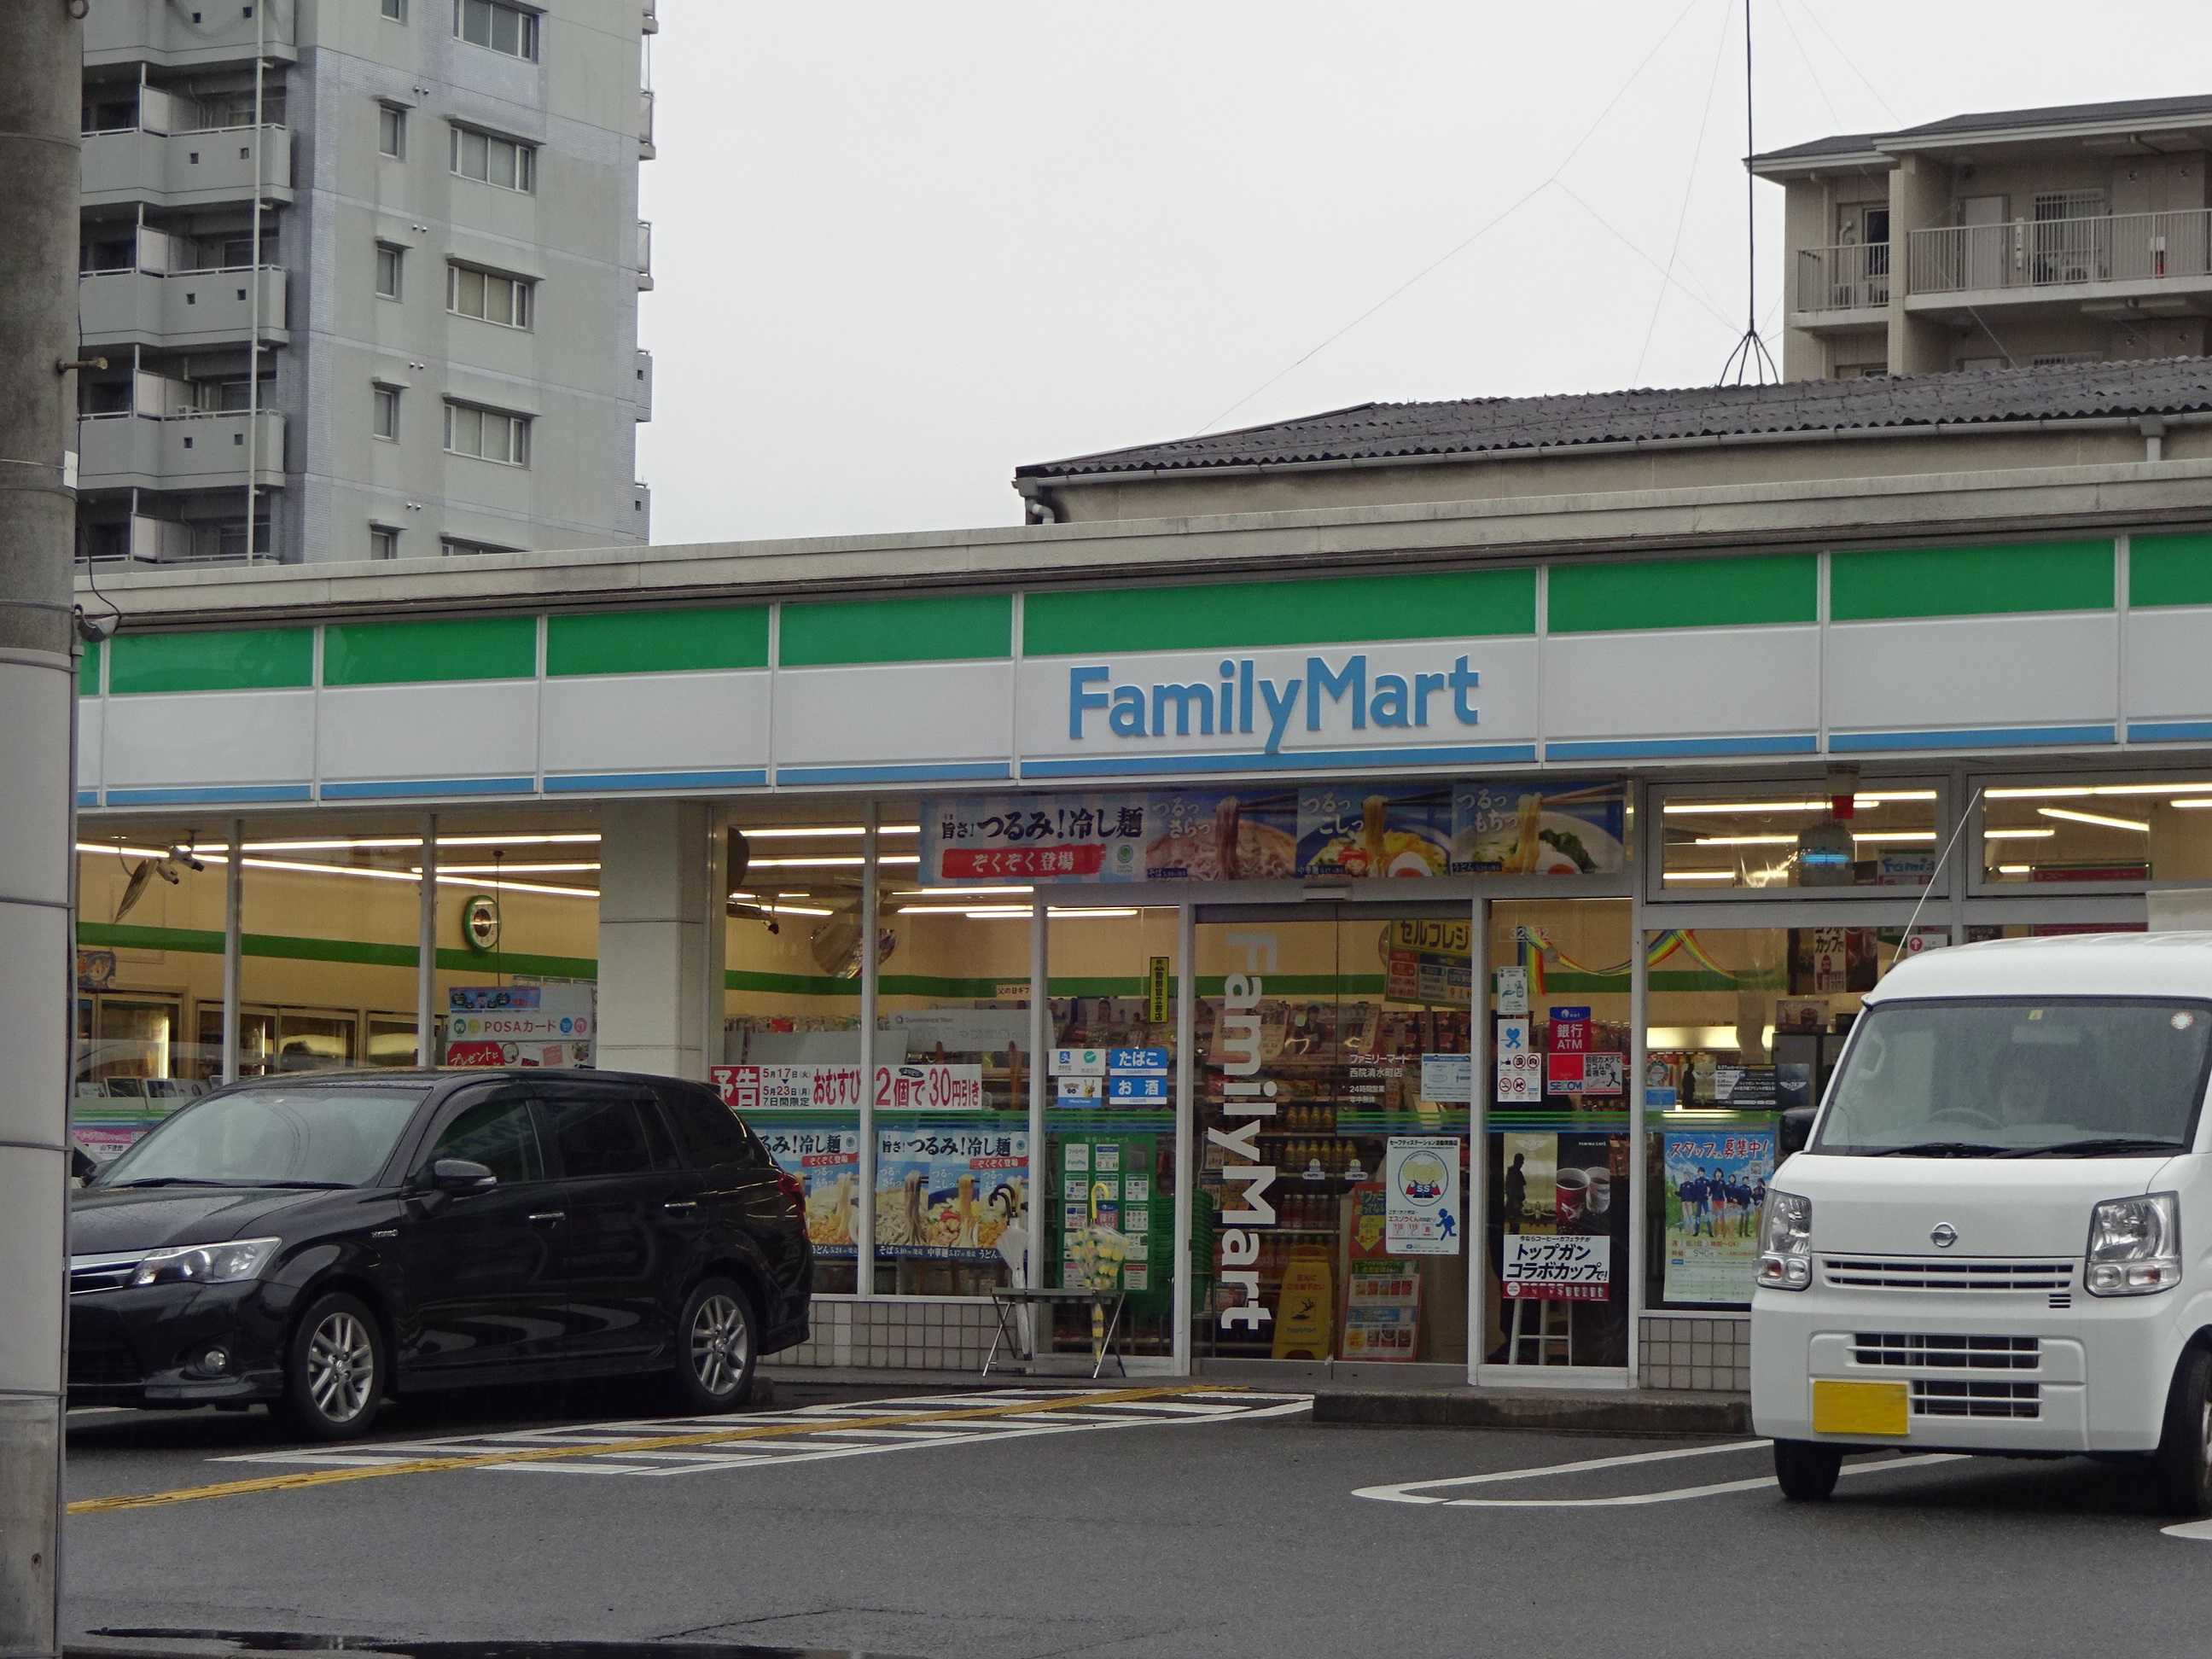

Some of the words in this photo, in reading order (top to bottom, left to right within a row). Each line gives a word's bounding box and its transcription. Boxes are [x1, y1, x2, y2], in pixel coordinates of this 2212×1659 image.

[1069, 655, 1480, 754] FamilyMart
[1301, 792, 1351, 812] つるっ
[1457, 788, 1507, 810] つるっ
[1168, 818, 1211, 839] さらっ
[1318, 814, 1364, 835] こしっ
[1475, 810, 1518, 833] もちっ
[972, 851, 1074, 873] ぞくぞく登場
[1400, 920, 1470, 951] セルフレジ
[484, 1020, 556, 1033] POSAカード
[1557, 1023, 1583, 1038] 銀行
[1557, 1039, 1583, 1049] ATM
[1119, 1051, 1159, 1067] たばこ
[1349, 1054, 1409, 1065] ファミリーマート
[713, 1068, 760, 1107] 予告
[1550, 1080, 1582, 1091] SECOM
[763, 1097, 810, 1107] 7日間限定
[1208, 932, 1278, 1330] FamilyMart
[1416, 1185, 1431, 1193] SS
[1517, 1243, 1592, 1261] トップガン
[1506, 1261, 1608, 1281] コラボカップで!
